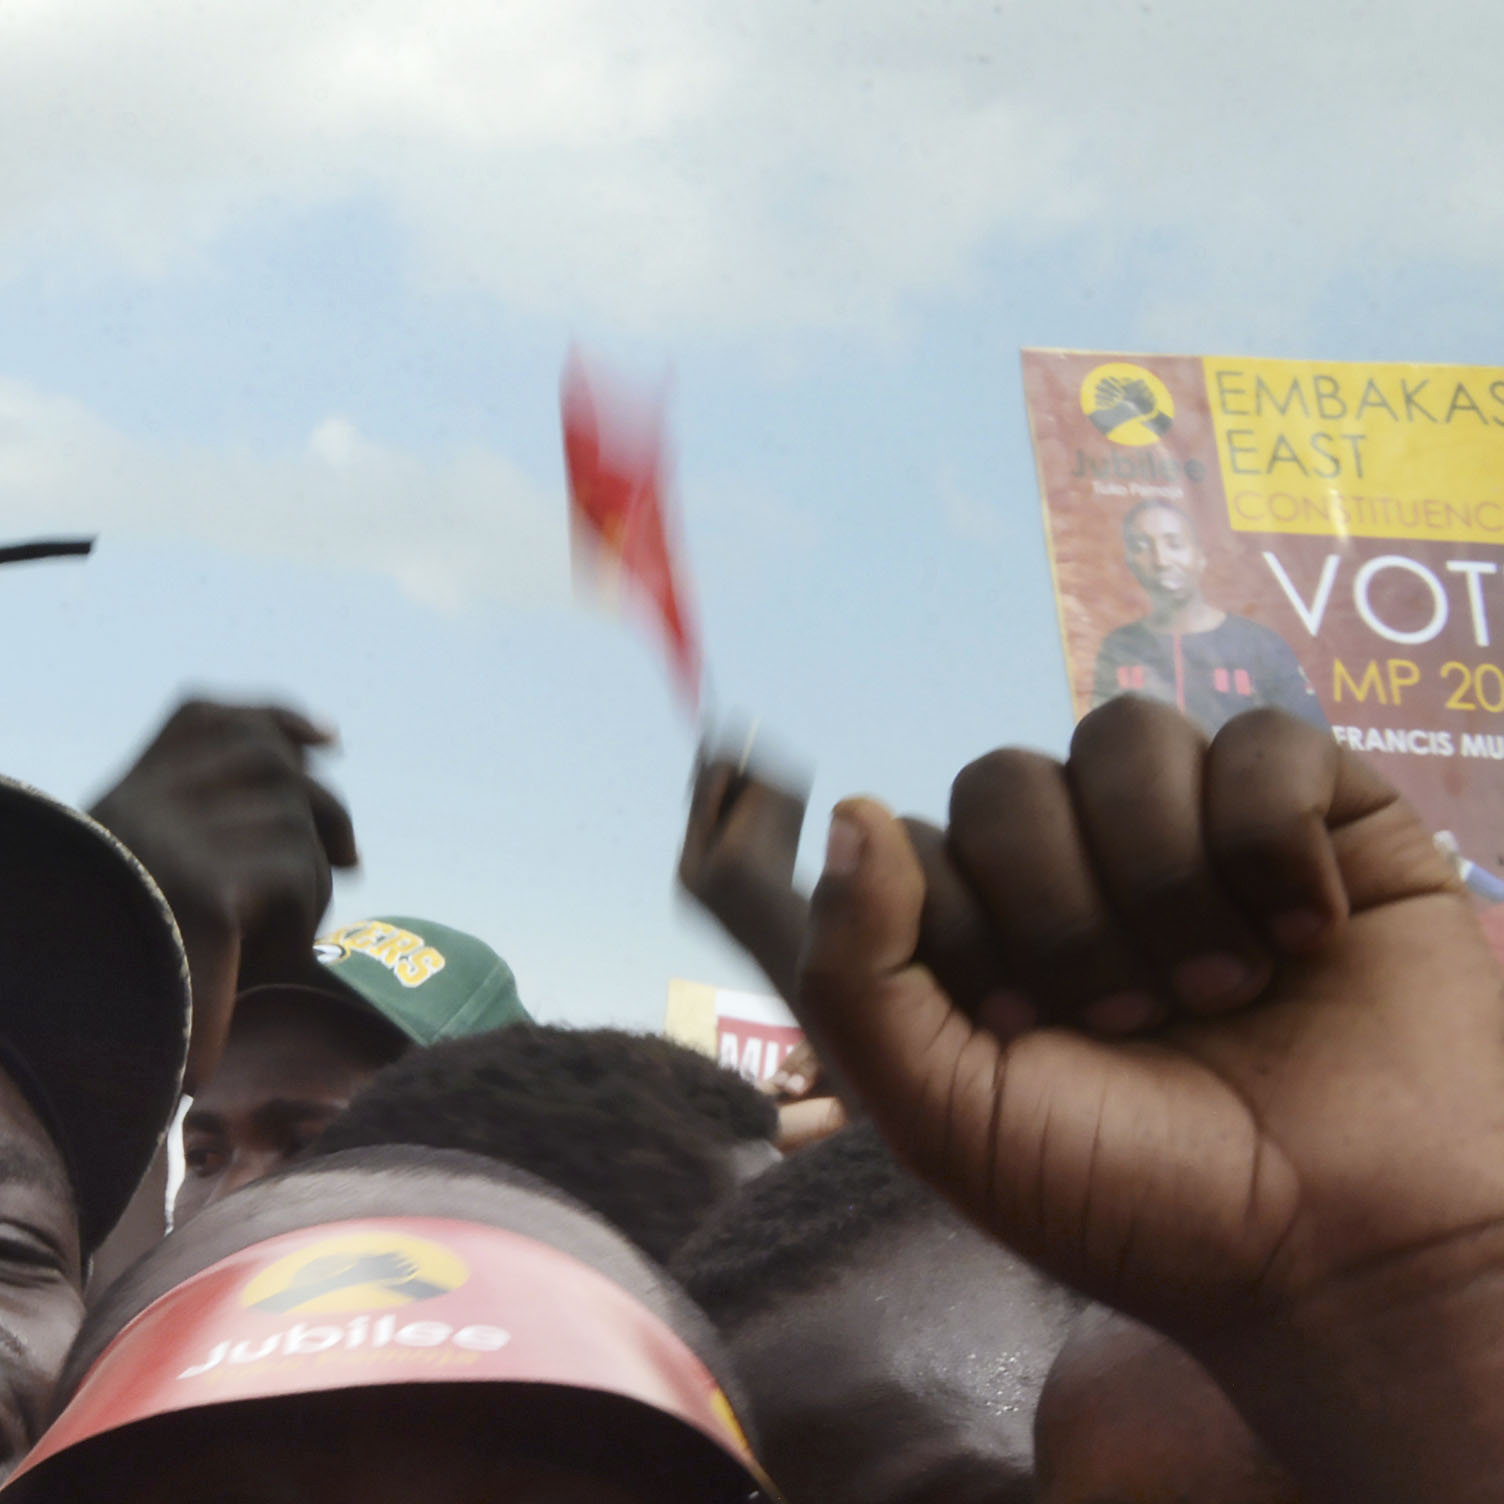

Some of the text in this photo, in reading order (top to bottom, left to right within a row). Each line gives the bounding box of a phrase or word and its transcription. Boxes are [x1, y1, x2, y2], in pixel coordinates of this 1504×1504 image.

[1226, 428, 1367, 479] EAST
[1332, 658, 1420, 706] MP
[1331, 724, 1454, 757] FRANCIS
[176, 1313, 512, 1380] Jubilee
